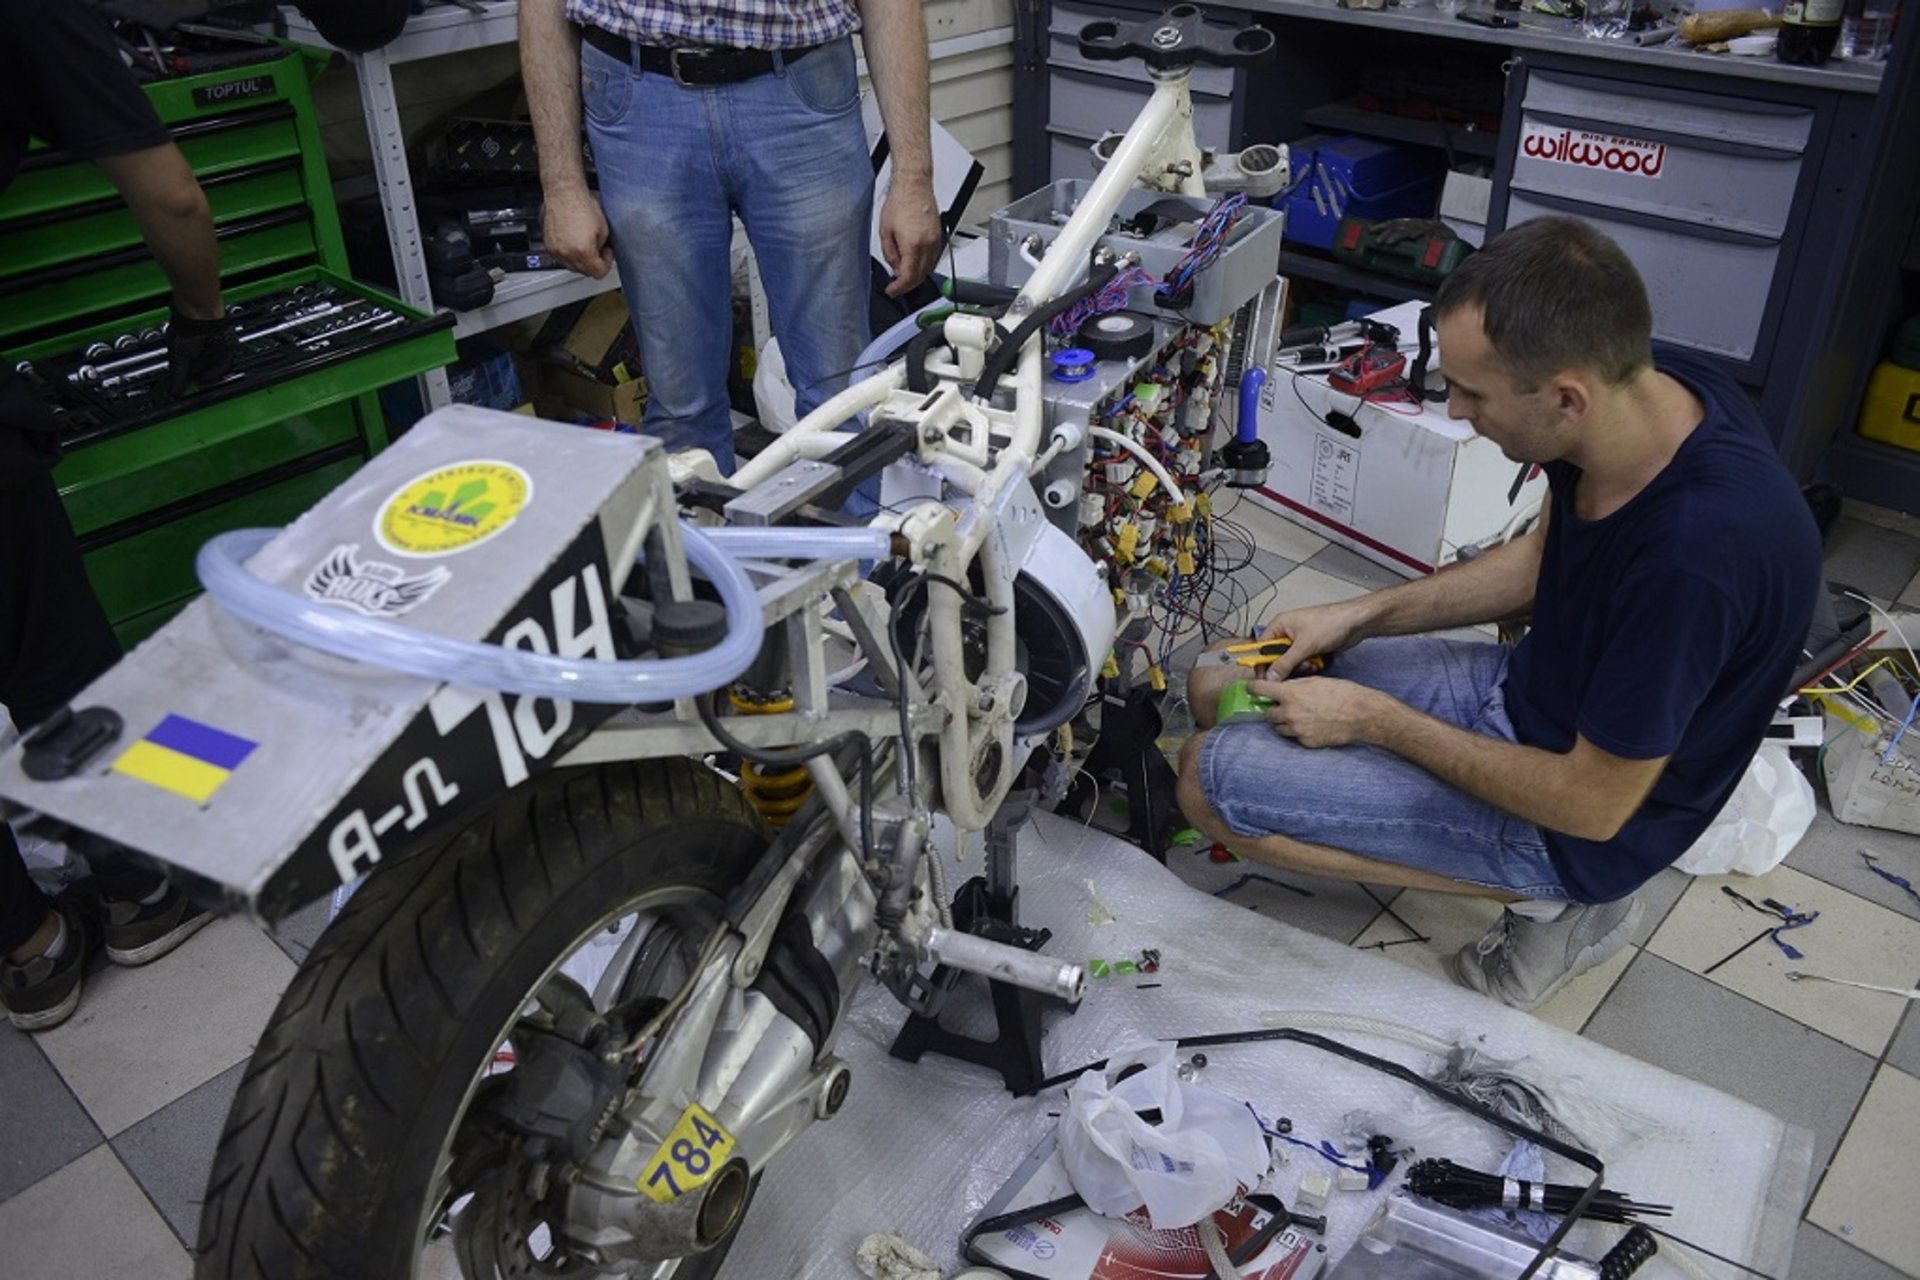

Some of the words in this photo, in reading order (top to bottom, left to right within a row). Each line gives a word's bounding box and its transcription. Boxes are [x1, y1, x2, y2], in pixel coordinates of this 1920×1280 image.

[205, 80, 259, 99] TOPTUL
[1524, 131, 1666, 176] wilwood
[1611, 137, 1657, 150] BRAKES
[647, 1115, 725, 1197] 784
